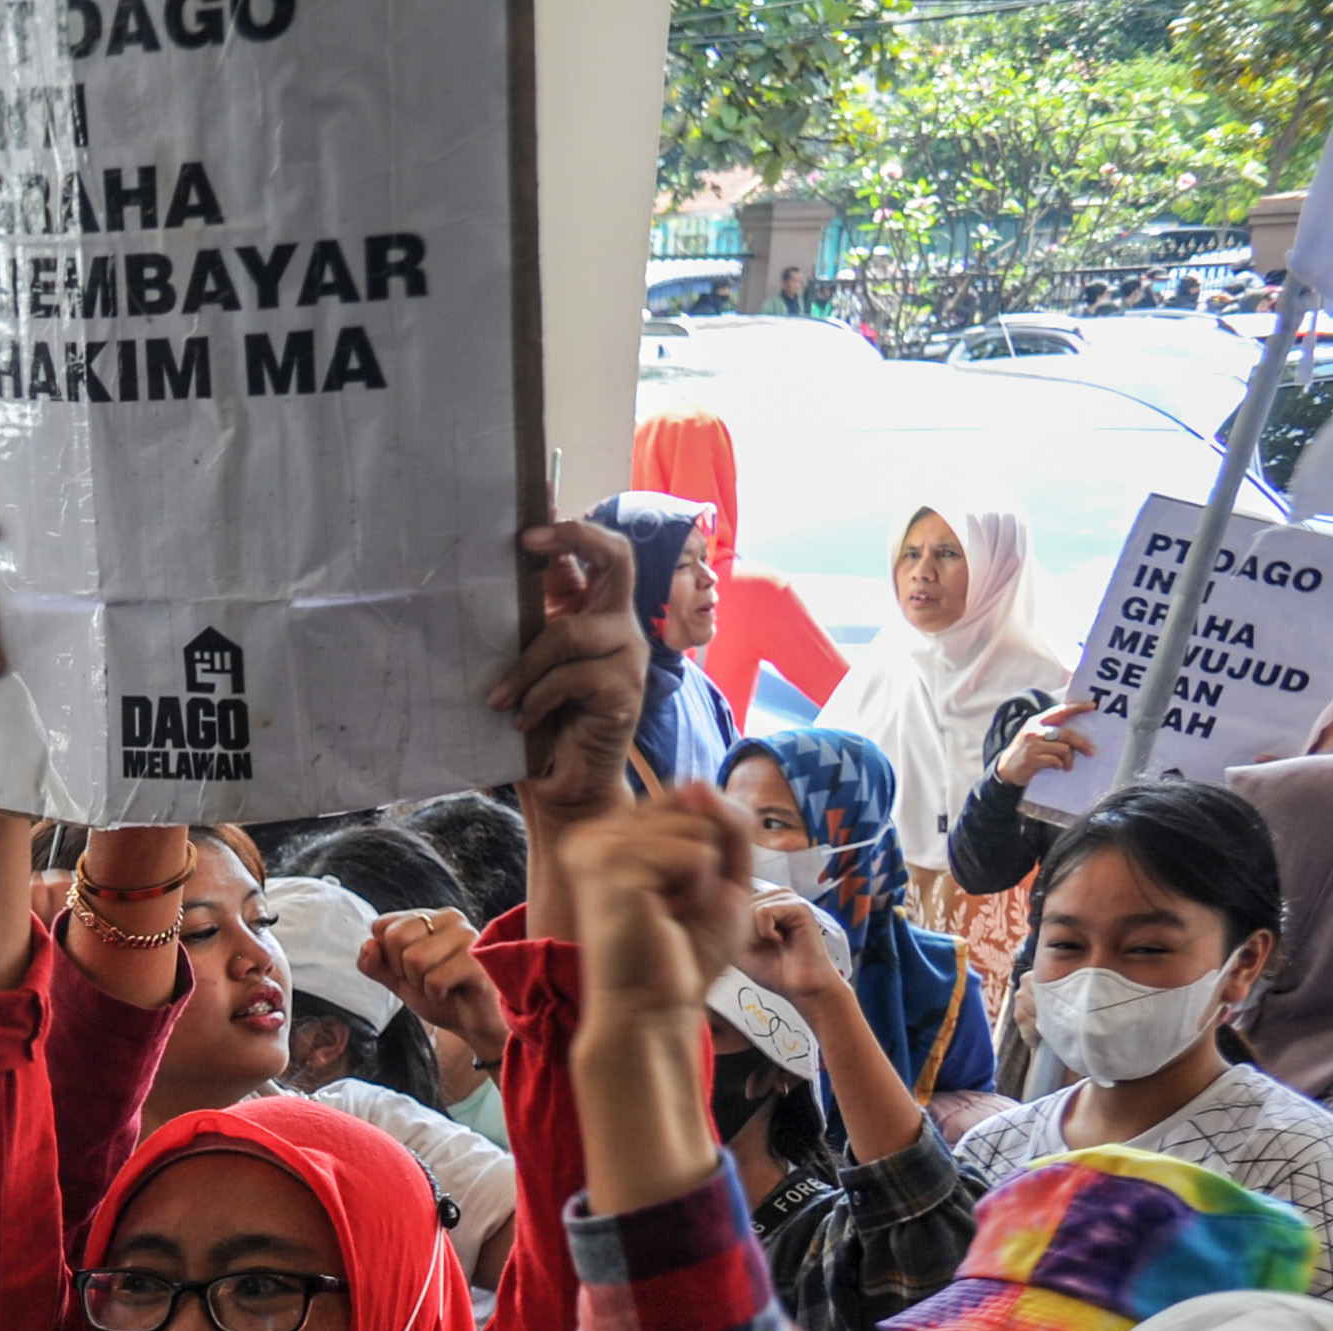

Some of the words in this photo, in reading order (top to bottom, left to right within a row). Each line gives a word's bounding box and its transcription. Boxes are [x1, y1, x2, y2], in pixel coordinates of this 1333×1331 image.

[55, 0, 296, 60] DAGO
[244, 325, 388, 397] MA
[1132, 564, 1216, 604] INI
[1096, 656, 1225, 708] SEAN
[121, 695, 251, 752] DAGO
[1089, 685, 1218, 740] TAAH
[122, 750, 254, 782] MELAWAN
